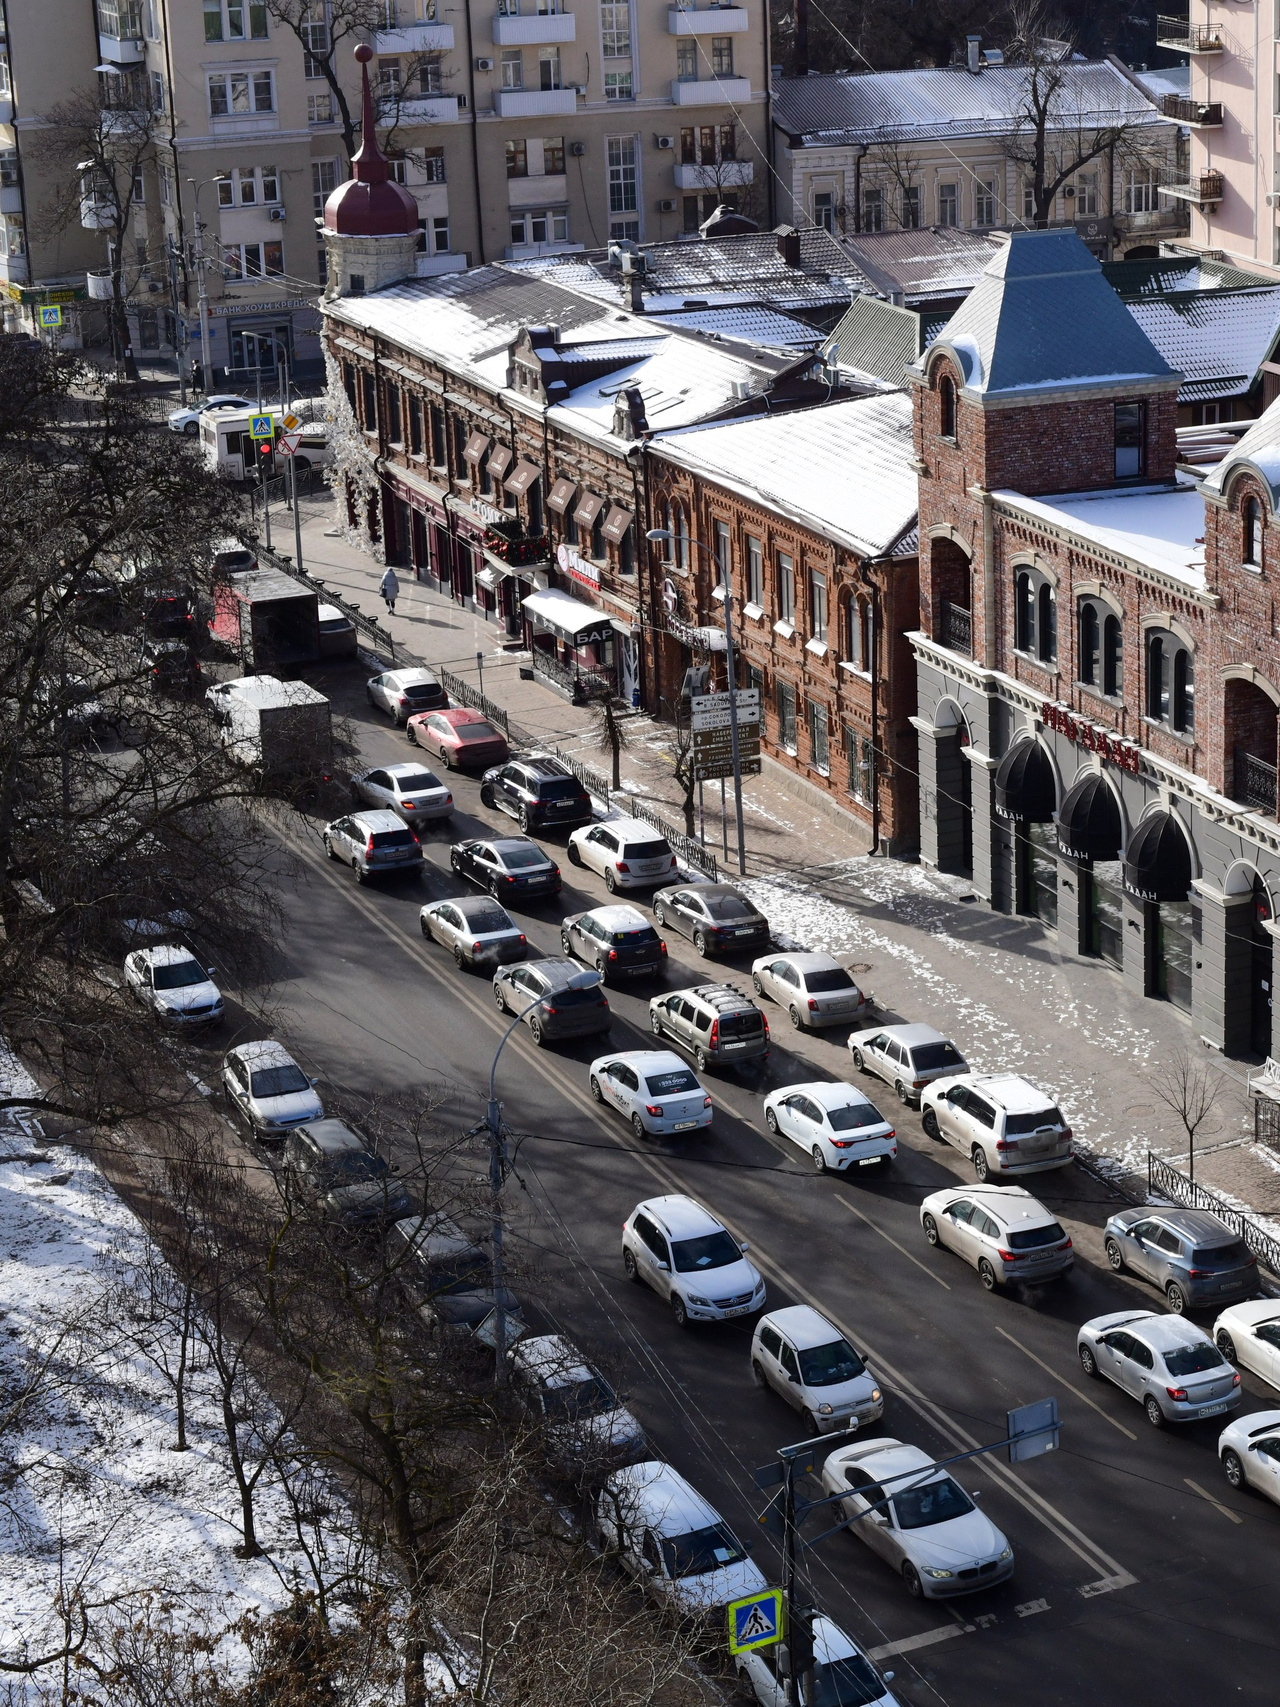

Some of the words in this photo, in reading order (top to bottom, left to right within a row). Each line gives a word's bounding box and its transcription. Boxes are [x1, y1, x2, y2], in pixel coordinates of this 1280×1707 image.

[216, 306, 241, 315] БАНК
[245, 303, 272, 312] ХОУМ
[274, 300, 308, 309] КРЕДИ
[576, 629, 612, 644] БАР
[1042, 701, 1139, 775] МАГАДАН
